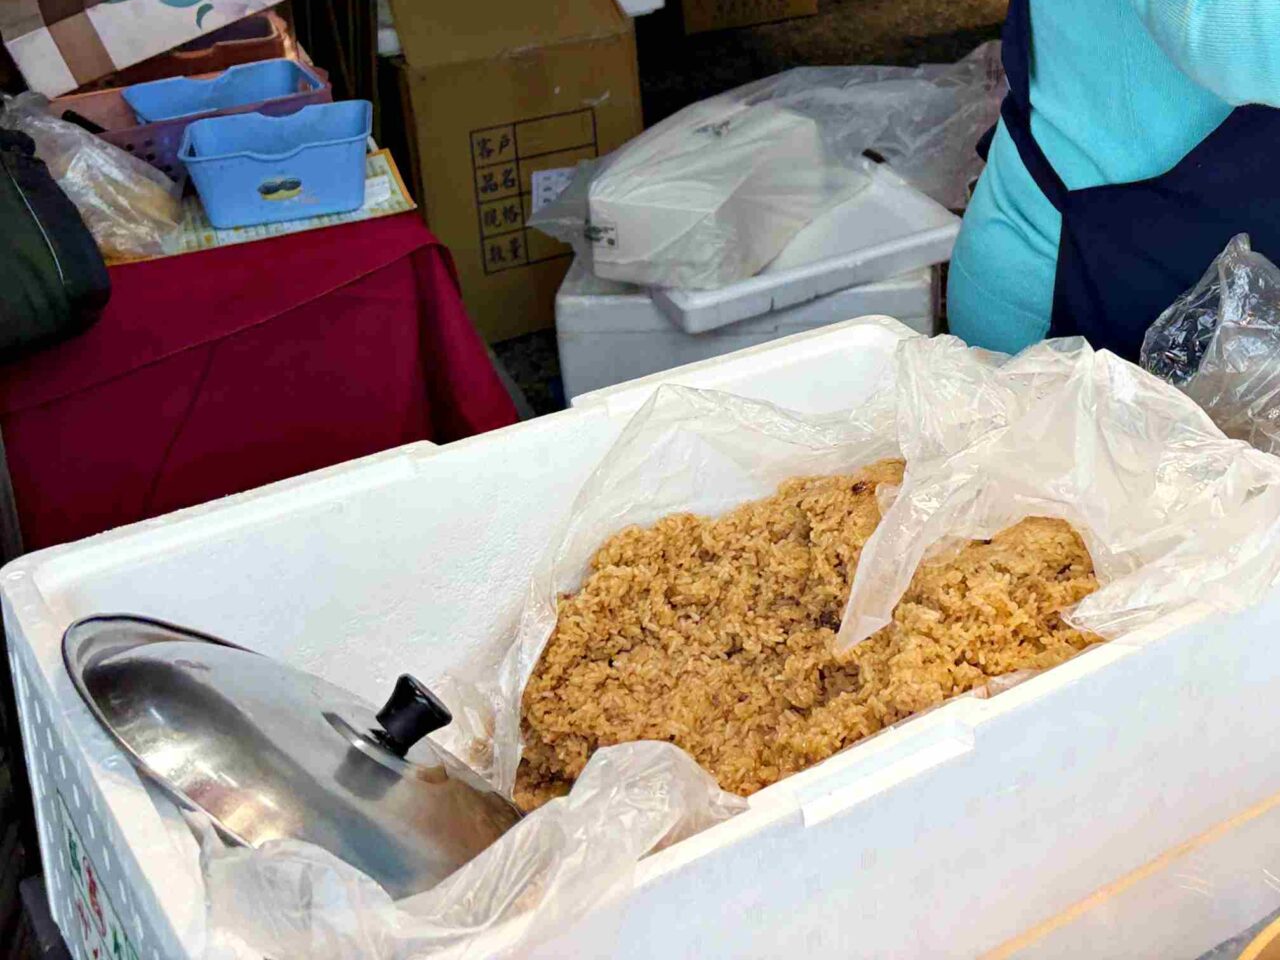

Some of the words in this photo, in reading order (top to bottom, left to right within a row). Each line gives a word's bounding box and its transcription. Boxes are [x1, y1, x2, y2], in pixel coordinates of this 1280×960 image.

[476, 134, 512, 159] 客戶
[480, 167, 517, 194] 品名
[484, 205, 521, 229] 規格
[489, 236, 523, 264] 數量
